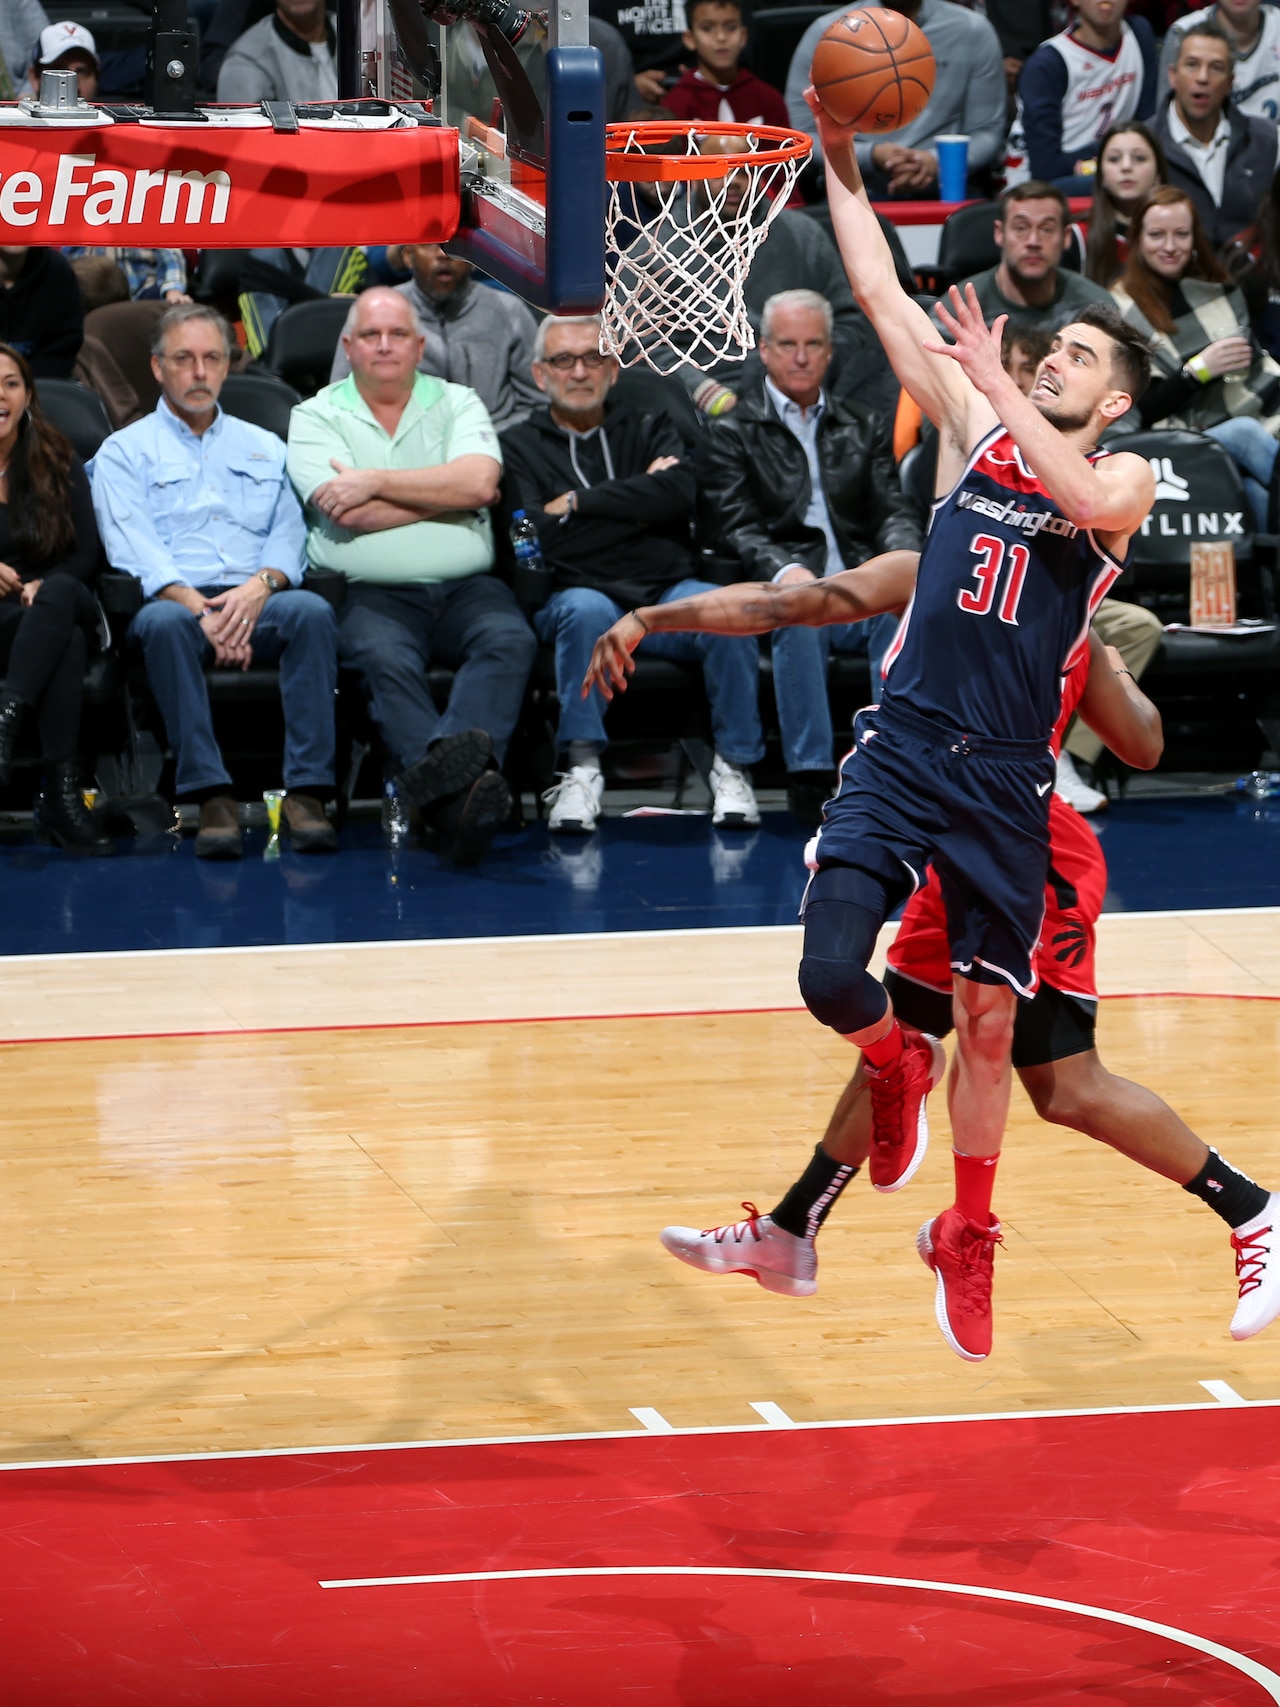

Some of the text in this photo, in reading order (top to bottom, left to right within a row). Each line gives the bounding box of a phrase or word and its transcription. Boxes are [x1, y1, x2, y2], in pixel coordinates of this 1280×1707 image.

[634, 18, 673, 35] FACE
[1140, 511, 1245, 537] TLINX
[956, 532, 1030, 626] 31
